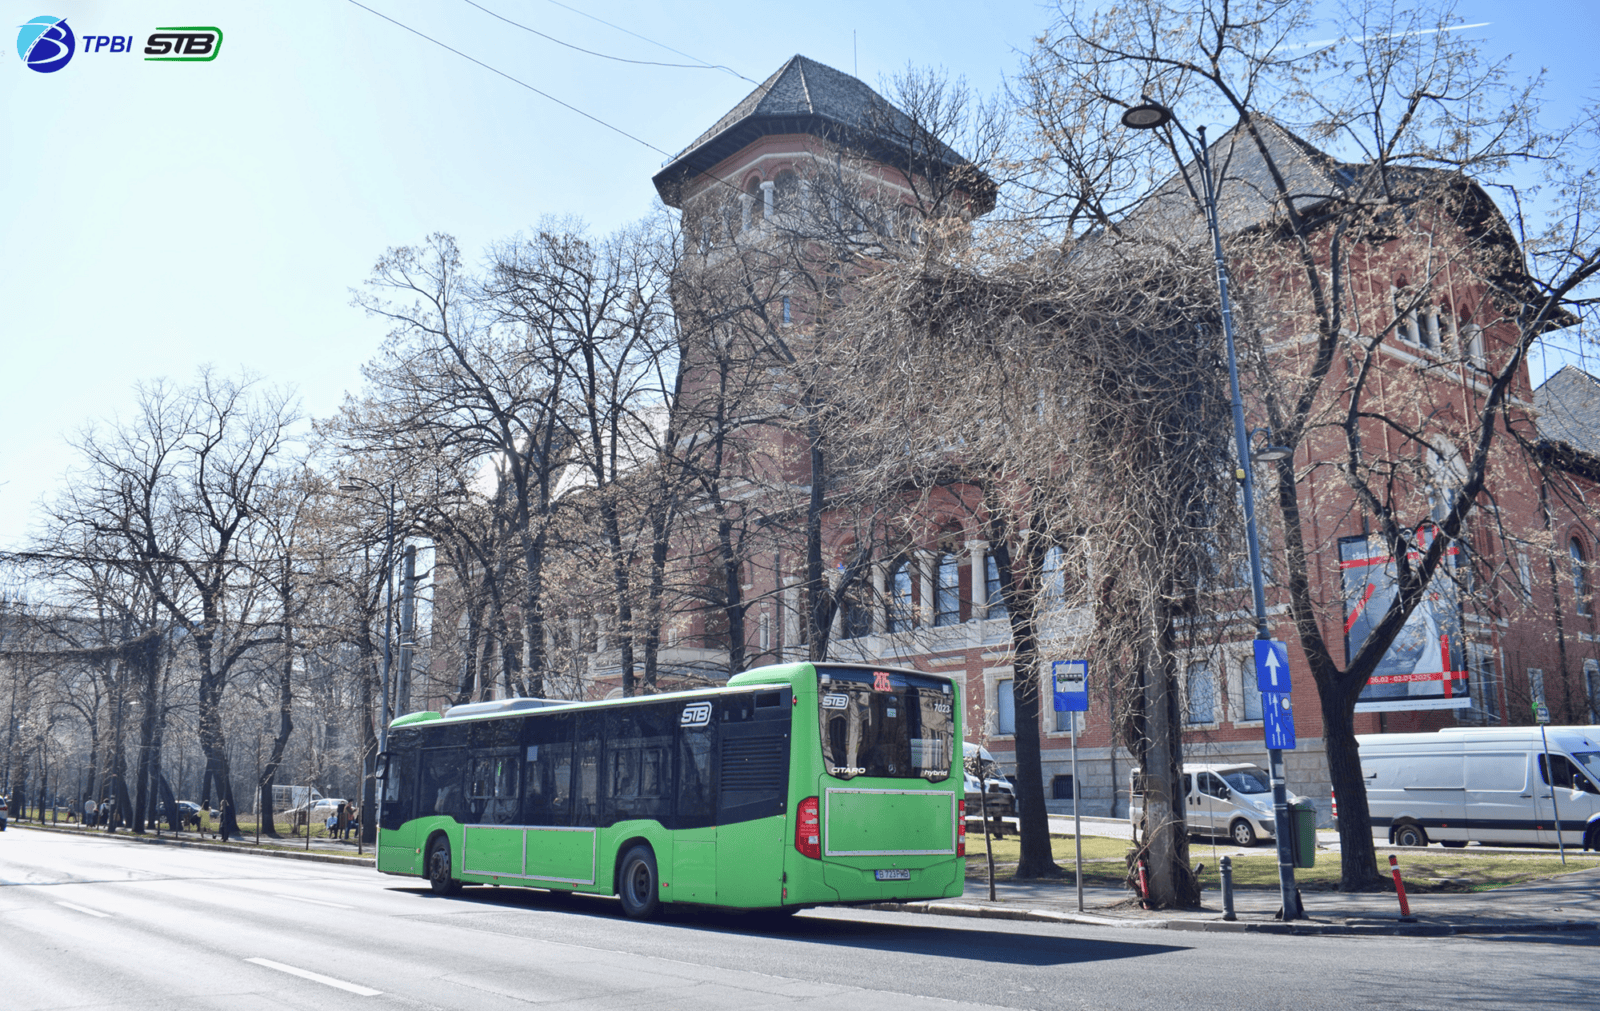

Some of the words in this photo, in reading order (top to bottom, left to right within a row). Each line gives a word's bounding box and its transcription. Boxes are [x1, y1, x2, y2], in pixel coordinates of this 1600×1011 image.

[1370, 676, 1389, 684] 26.02
[1393, 673, 1432, 683] 02.03.2025
[822, 695, 846, 706] STB
[934, 703, 951, 713] 7023
[680, 706, 709, 723] STB
[831, 766, 866, 774] CITARO
[924, 769, 948, 777] hybrid
